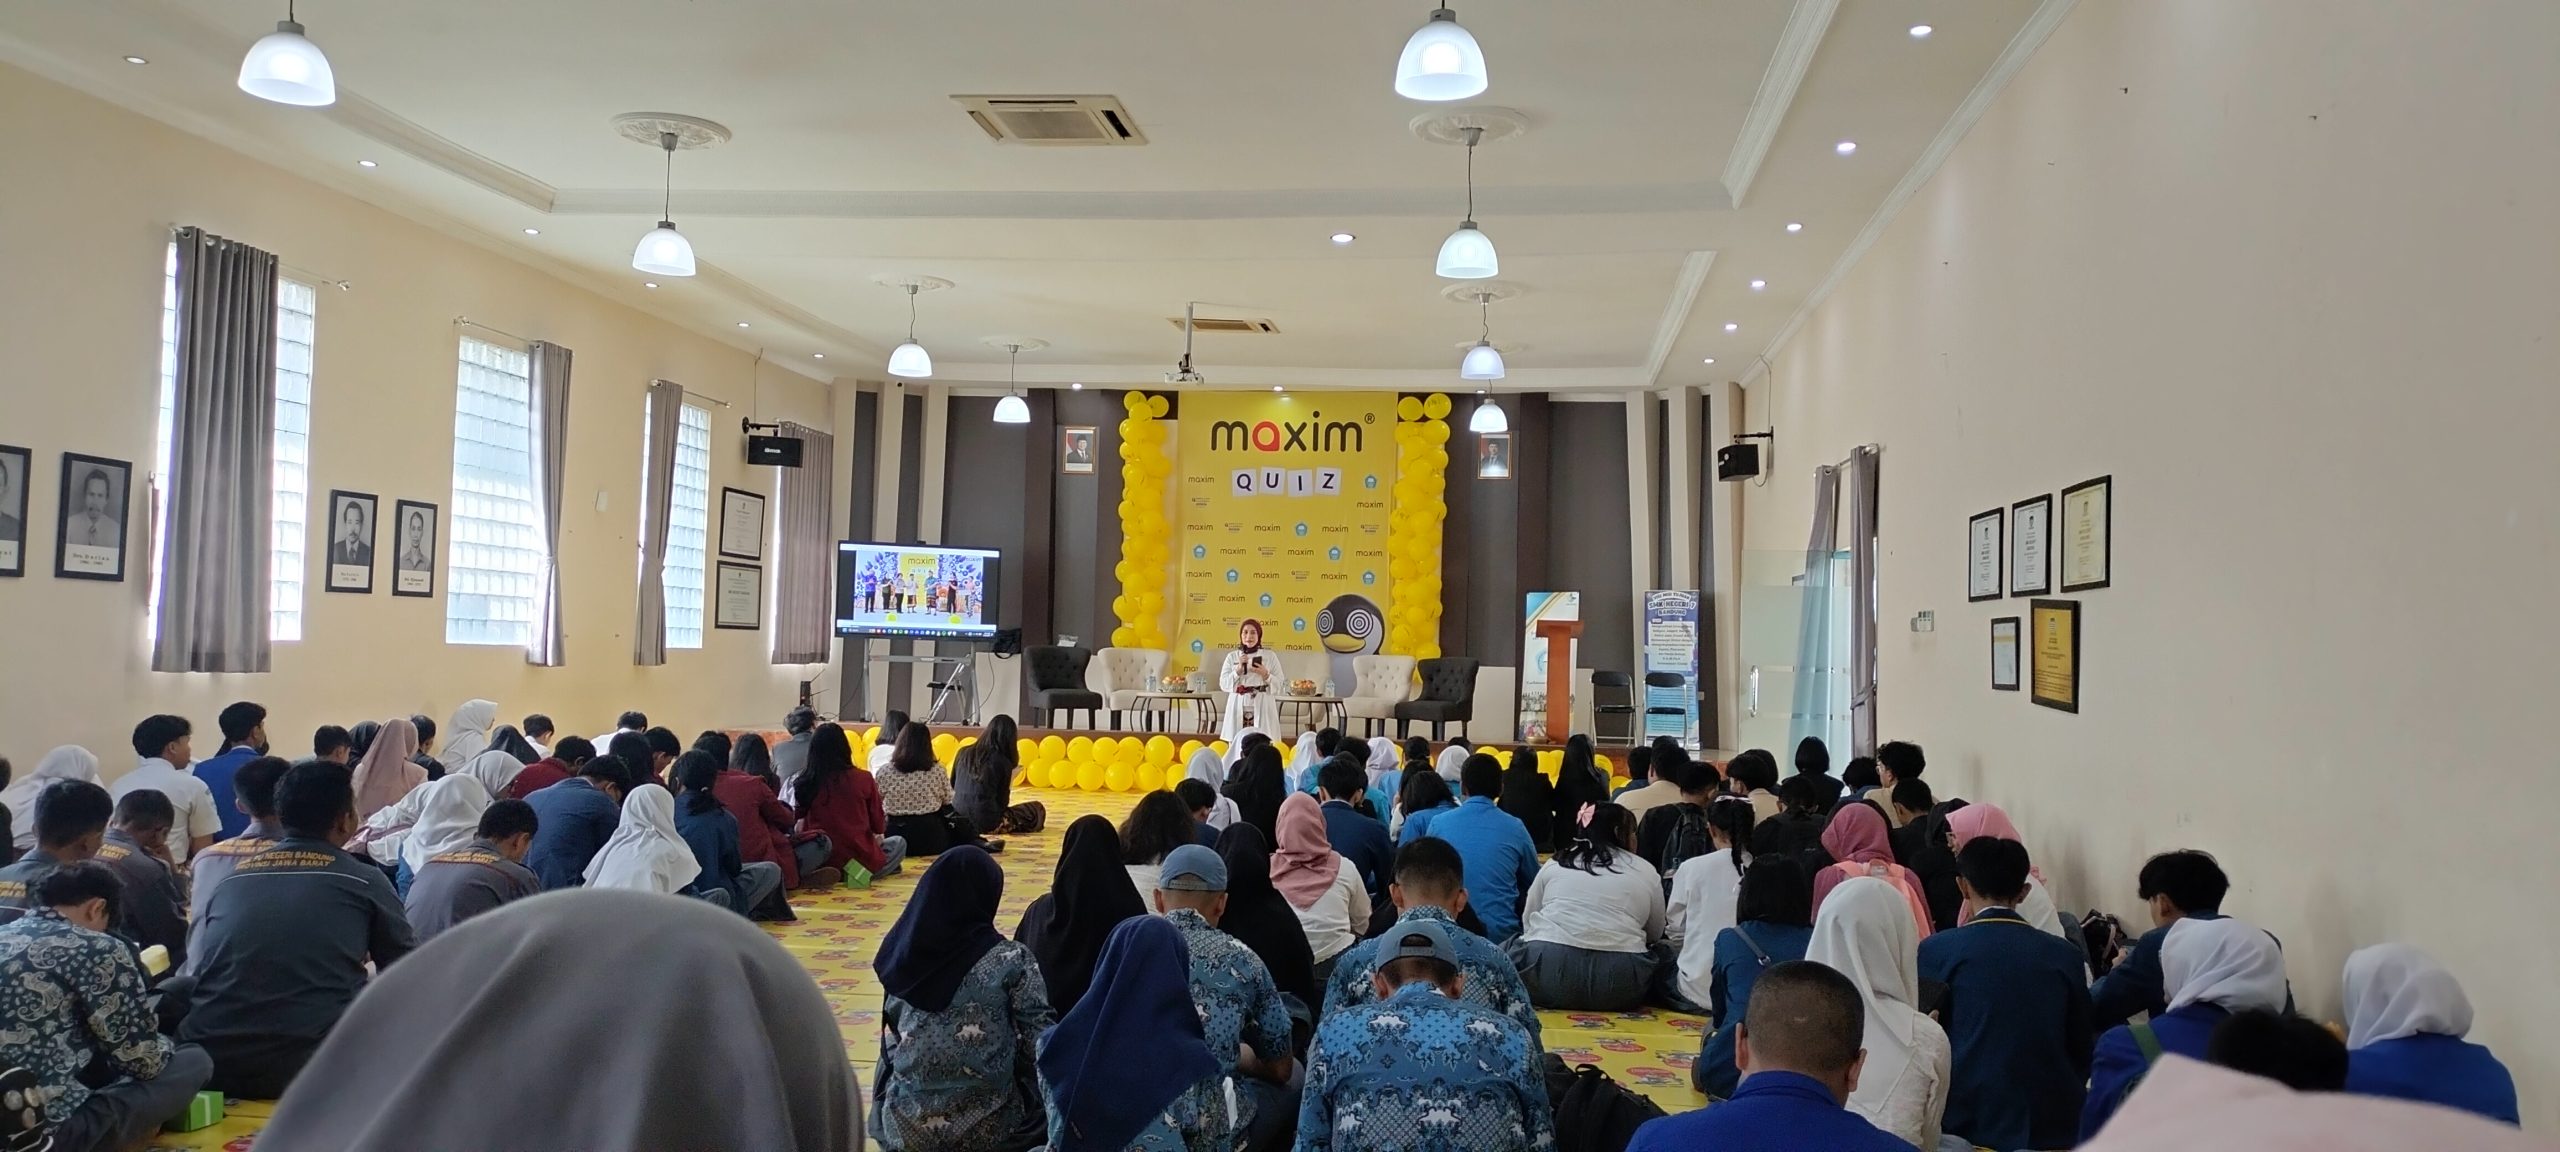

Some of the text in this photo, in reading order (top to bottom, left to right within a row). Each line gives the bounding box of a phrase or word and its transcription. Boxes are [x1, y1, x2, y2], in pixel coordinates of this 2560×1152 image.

[1211, 411, 1363, 452] maxim
[1187, 475, 1215, 483] maxim
[1236, 472, 1335, 492] QUIZ
[1186, 523, 1214, 531] maxim
[1254, 524, 1281, 532] maxim
[1321, 525, 1349, 533] maxim
[1219, 547, 1247, 555] maxim
[1287, 548, 1315, 556] maxim
[1355, 549, 1383, 557] maxim
[907, 556, 936, 565] maxim
[1185, 569, 1213, 578] maxim
[1253, 571, 1280, 579] maxim
[1320, 572, 1348, 580] maxim
[1218, 594, 1246, 602] maxim
[1286, 595, 1314, 604] maxim
[1184, 617, 1212, 625] maxim
[1285, 643, 1313, 651] maxim
